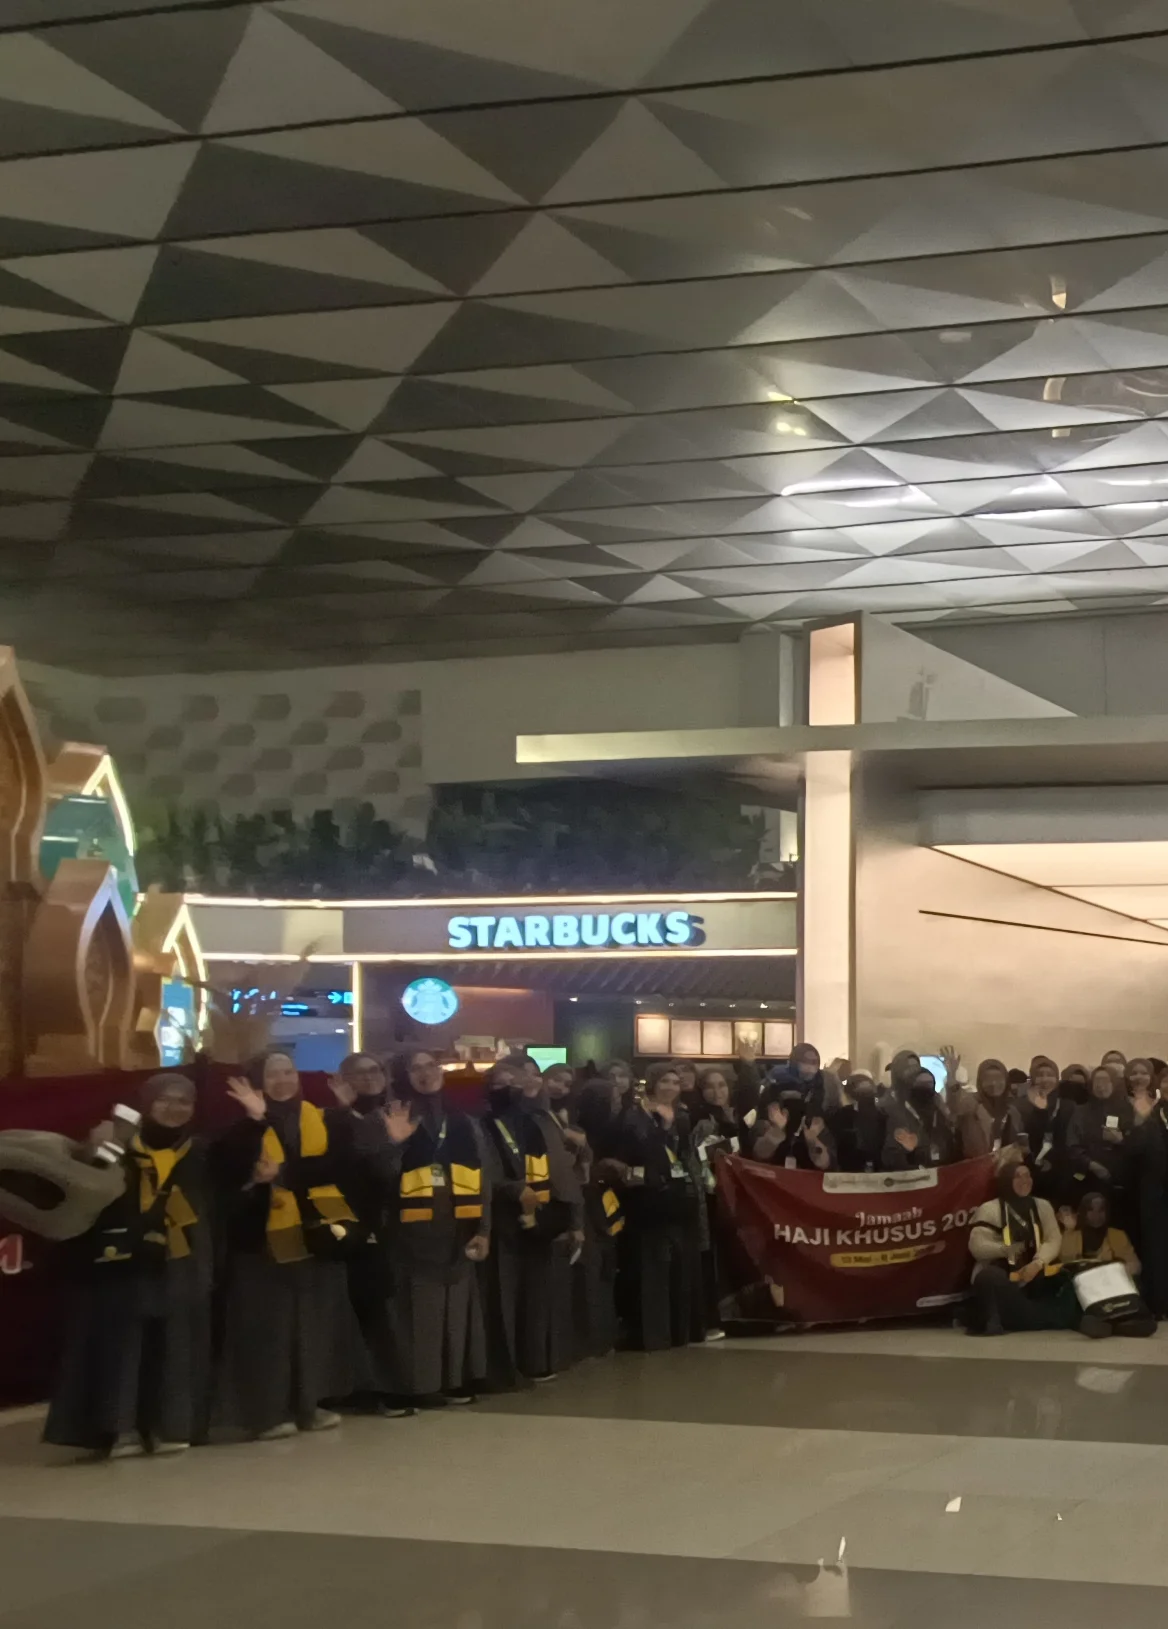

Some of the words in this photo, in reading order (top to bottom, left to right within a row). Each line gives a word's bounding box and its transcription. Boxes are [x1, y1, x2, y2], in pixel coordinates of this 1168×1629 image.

[447, 911, 693, 949] STARBUCKS
[773, 1223, 831, 1246] HAJI
[836, 1222, 937, 1246] KHUSUS
[941, 1207, 980, 1232] 202
[855, 1206, 924, 1228] Jamaah
